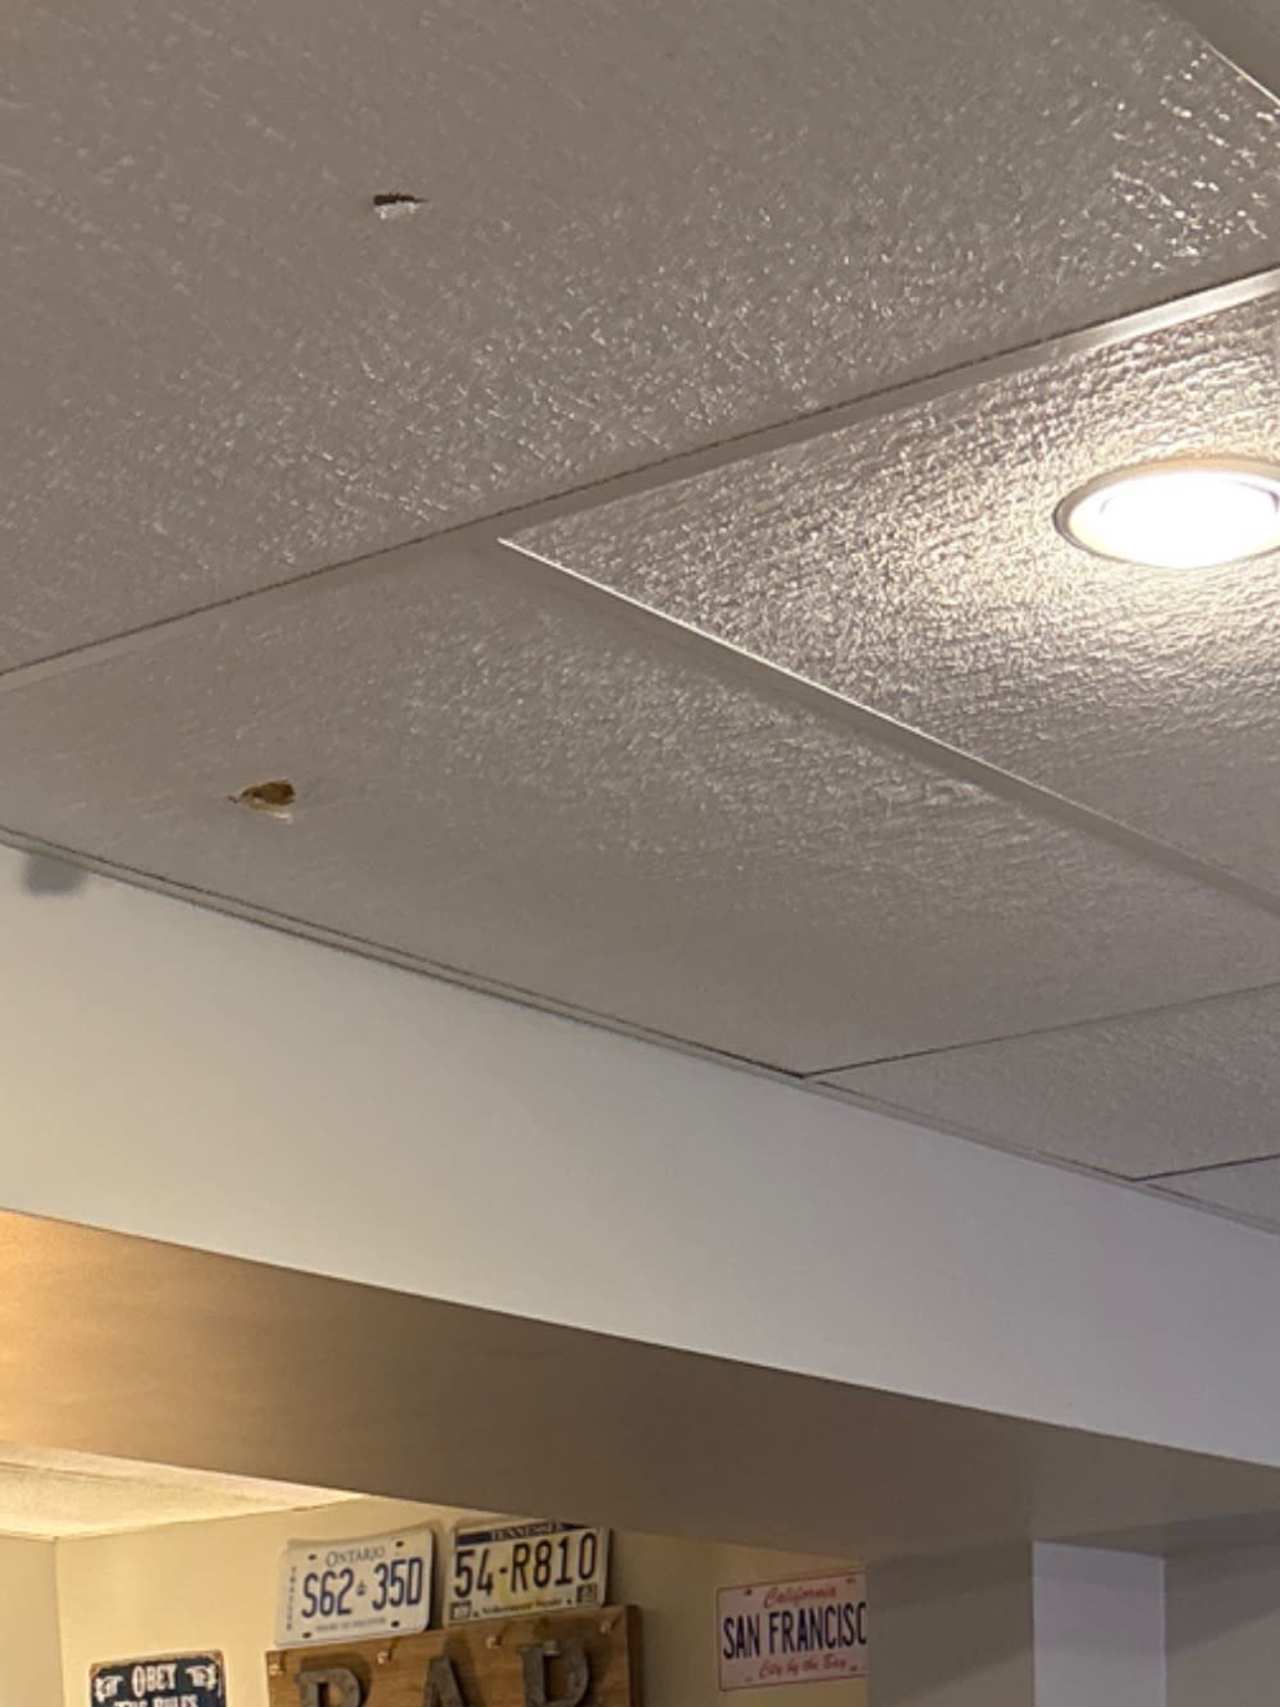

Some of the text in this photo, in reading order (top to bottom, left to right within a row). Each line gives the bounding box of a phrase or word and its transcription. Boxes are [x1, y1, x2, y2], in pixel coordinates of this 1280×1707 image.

[325, 1546, 386, 1567] ONTARIO
[455, 1532, 597, 1598] 54-R810
[302, 1557, 423, 1618] S62 35D
[723, 1602, 867, 1660] SAN FRANCISC
[131, 1663, 178, 1698] OBEY
